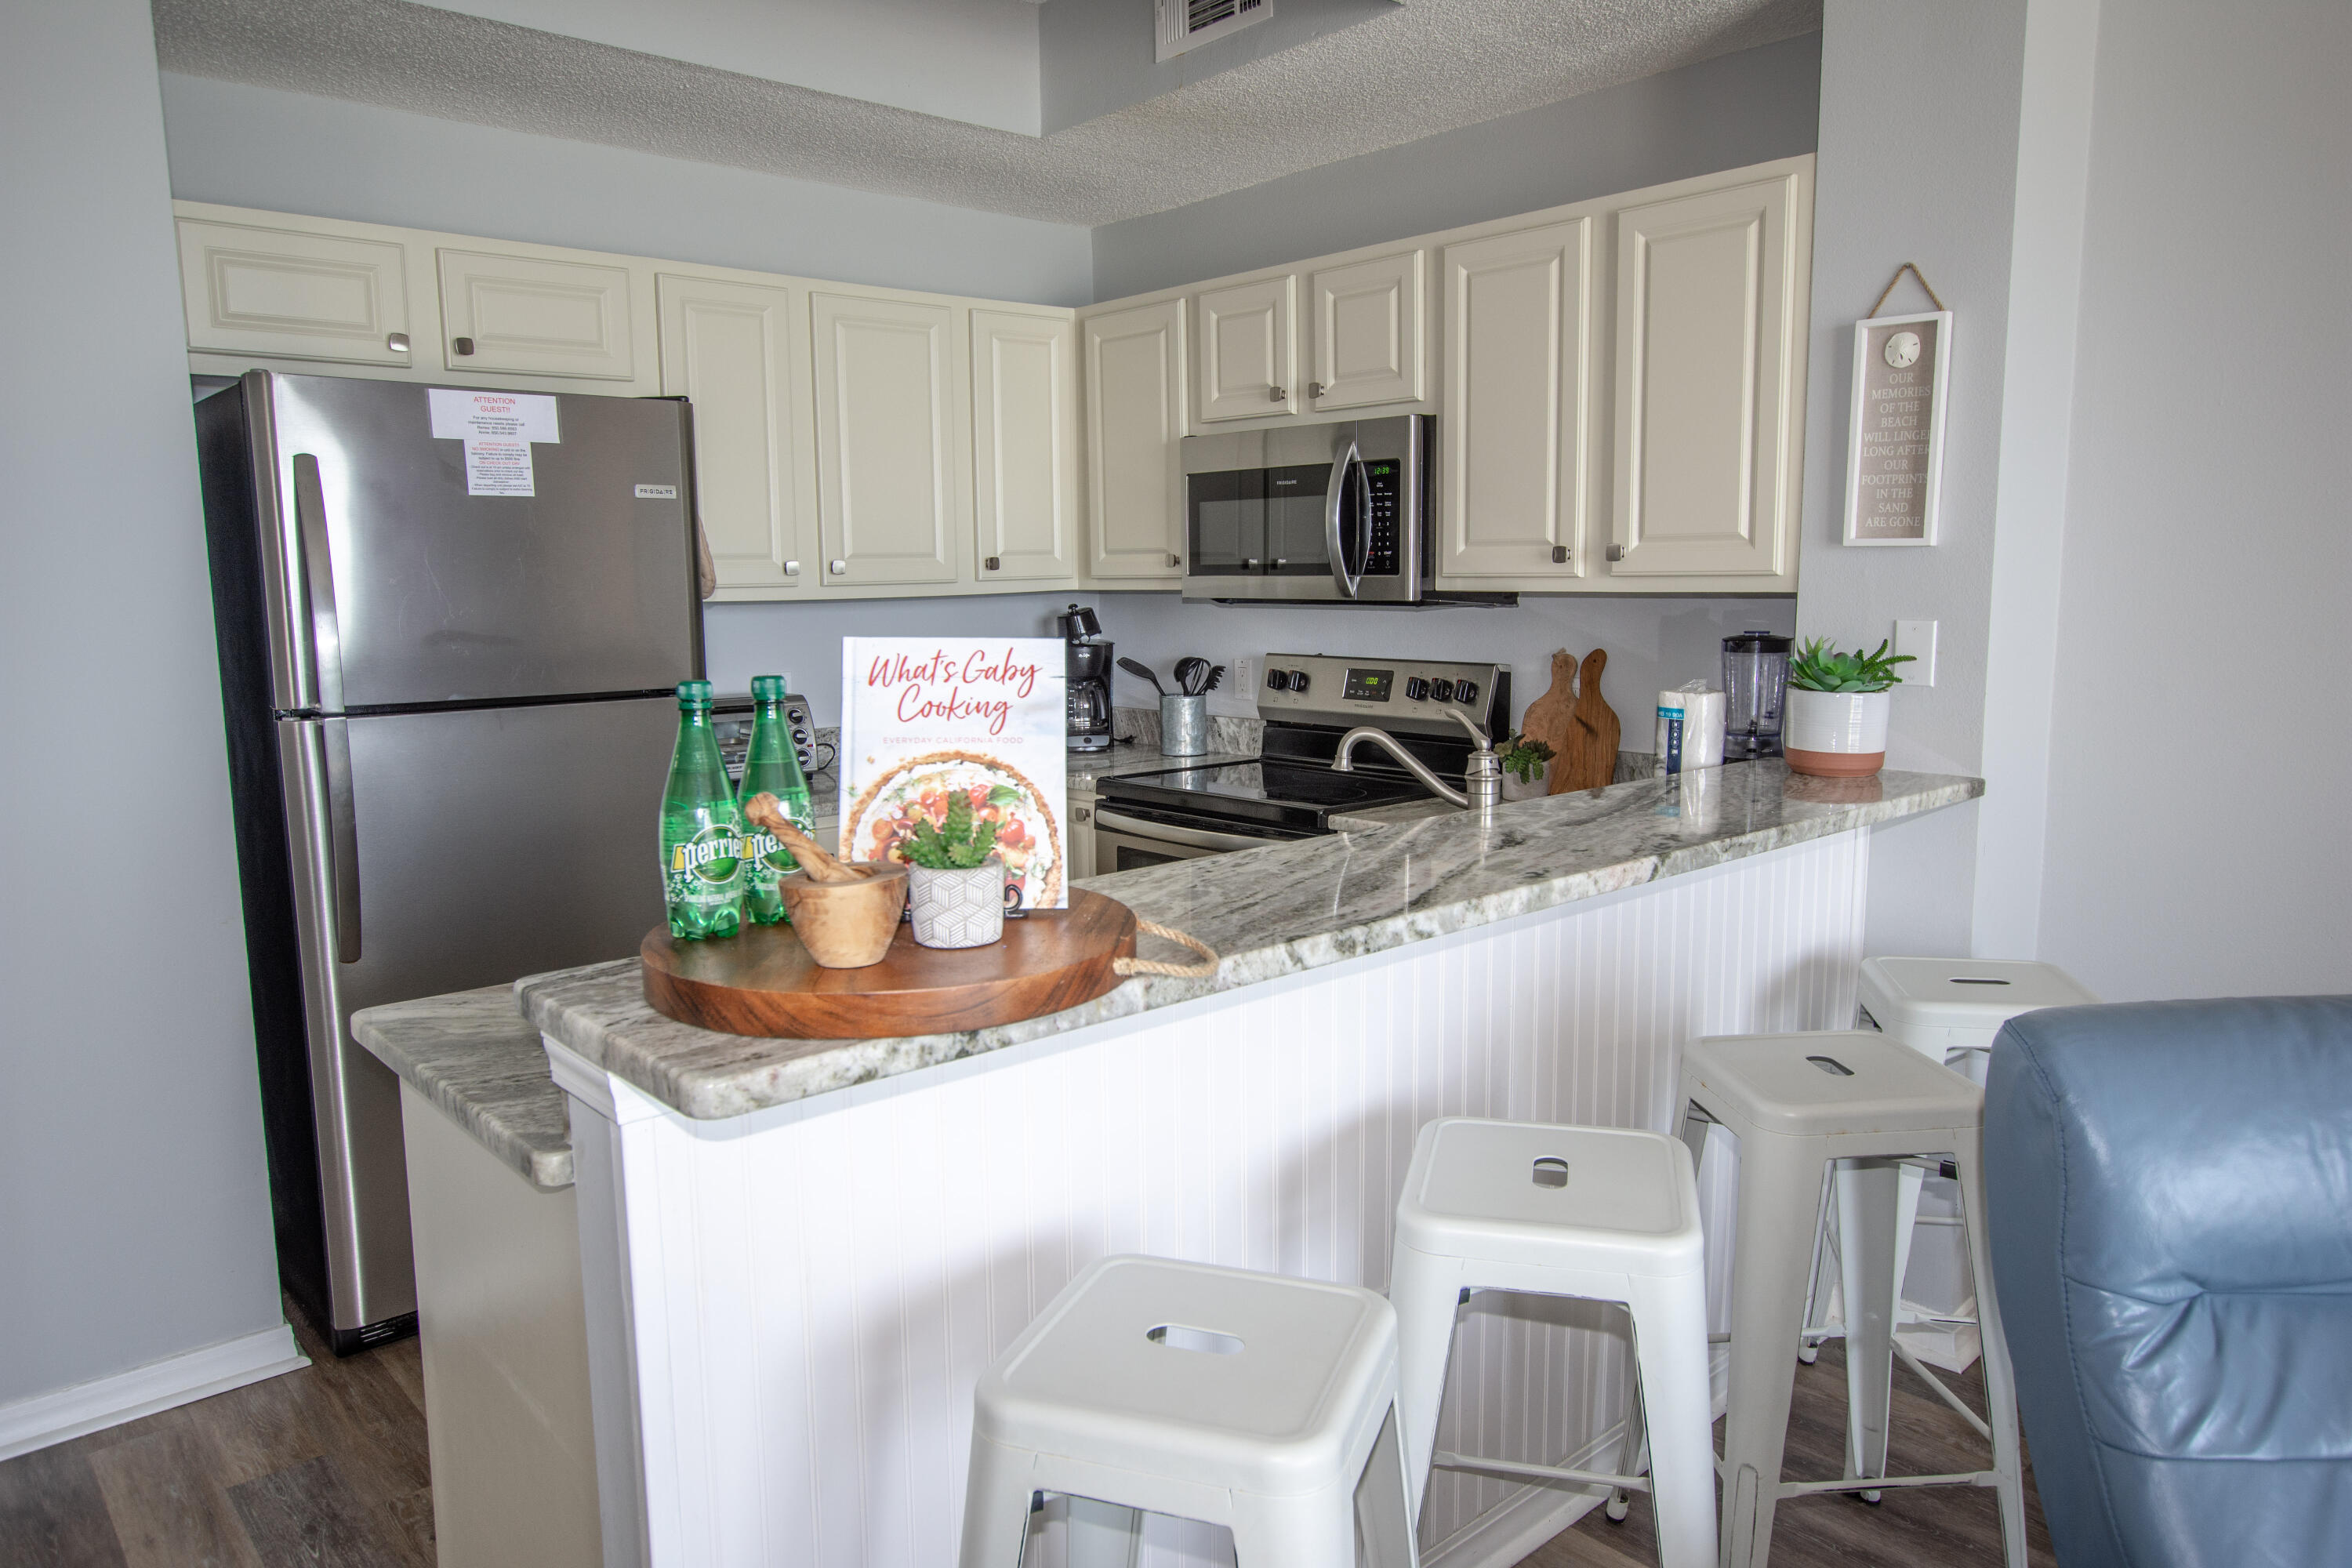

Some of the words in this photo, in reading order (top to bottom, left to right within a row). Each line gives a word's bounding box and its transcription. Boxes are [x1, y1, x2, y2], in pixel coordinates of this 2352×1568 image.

[1889, 372, 1914, 384] OUR
[1871, 386, 1932, 400] MEMORIES
[473, 396, 516, 405] ATTENTION
[1880, 402, 1896, 414] OF
[1897, 401, 1920, 412] THE
[1881, 416, 1918, 428] BEACH
[1864, 431, 1891, 443] WILL
[1863, 445, 1894, 457] LONG
[1374, 466, 1389, 475] 12:39
[1884, 459, 1908, 470] OUR
[1876, 488, 1888, 499] IN
[1891, 488, 1913, 499] THE
[1878, 502, 1908, 514] SAND
[1865, 517, 1886, 528] ARE
[1889, 516, 1920, 527] GONE
[868, 649, 958, 688] What's
[963, 647, 1043, 699] Gaby
[898, 683, 1014, 735] Cooking
